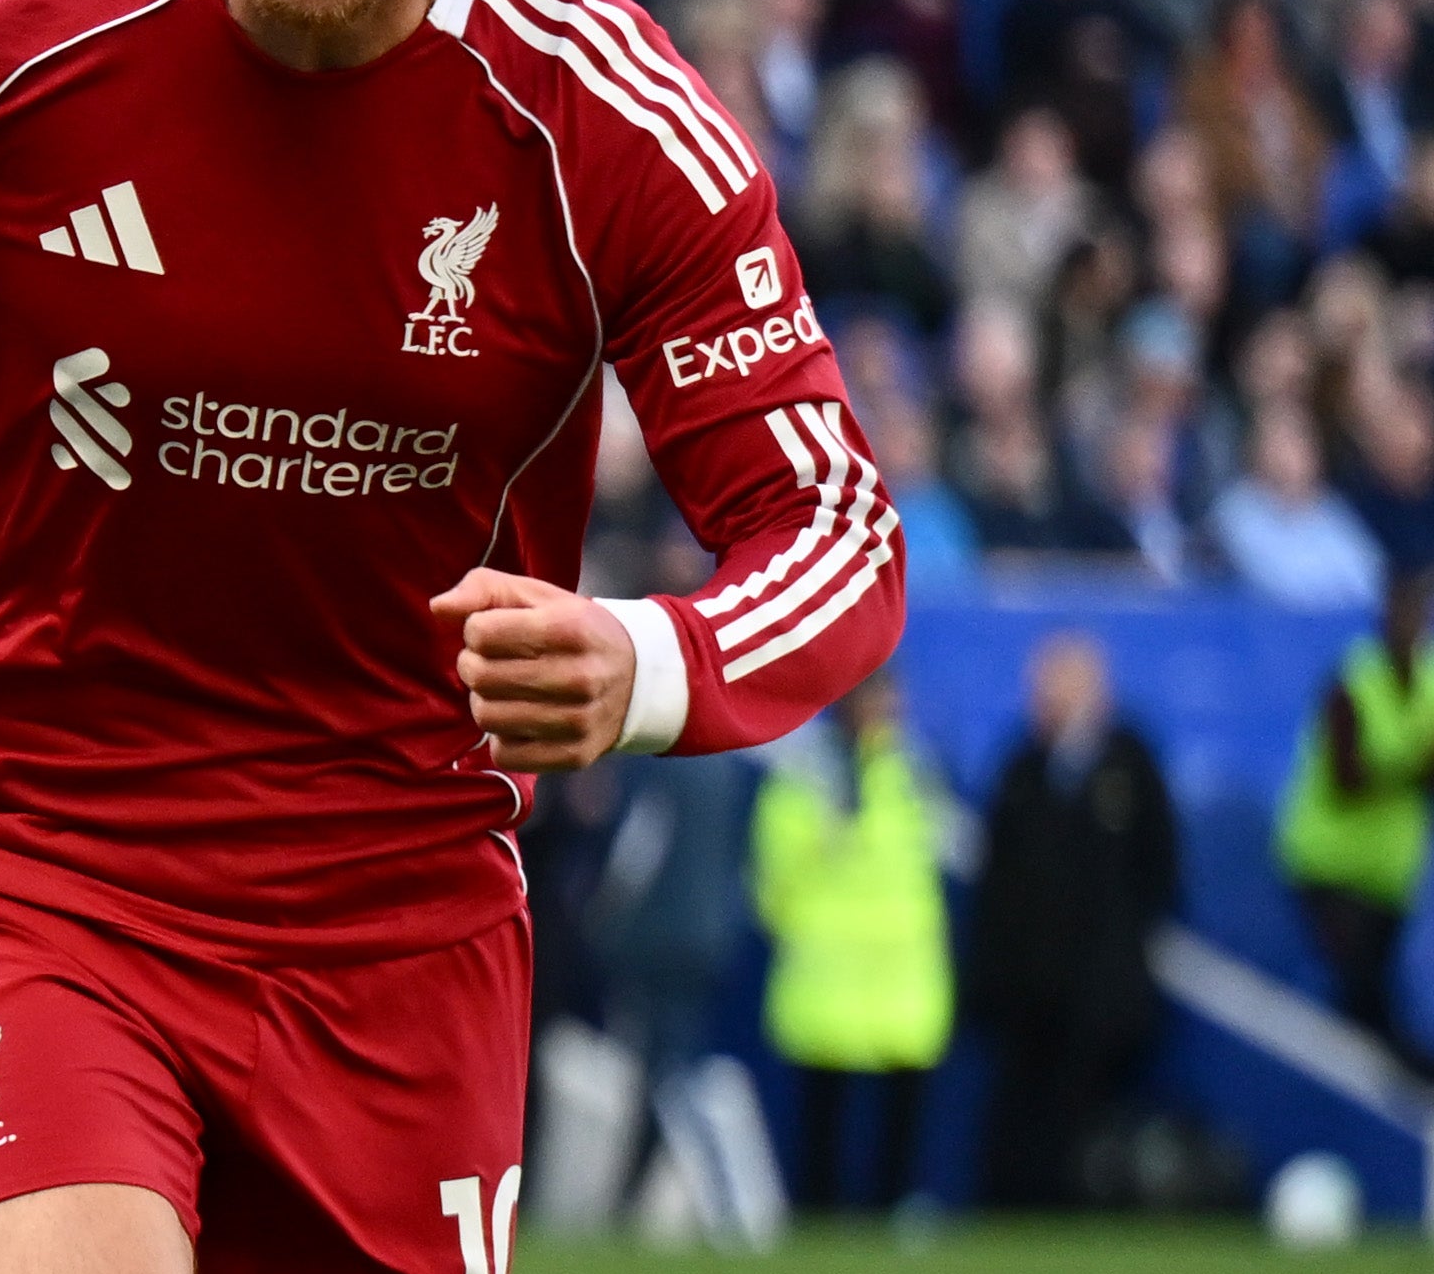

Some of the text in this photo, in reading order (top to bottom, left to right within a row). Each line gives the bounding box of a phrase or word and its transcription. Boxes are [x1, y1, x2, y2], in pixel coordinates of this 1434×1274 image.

[400, 322, 480, 357] L.F.C.
[662, 294, 825, 388] Exped
[160, 391, 459, 456] standard
[158, 438, 459, 497] chartered
